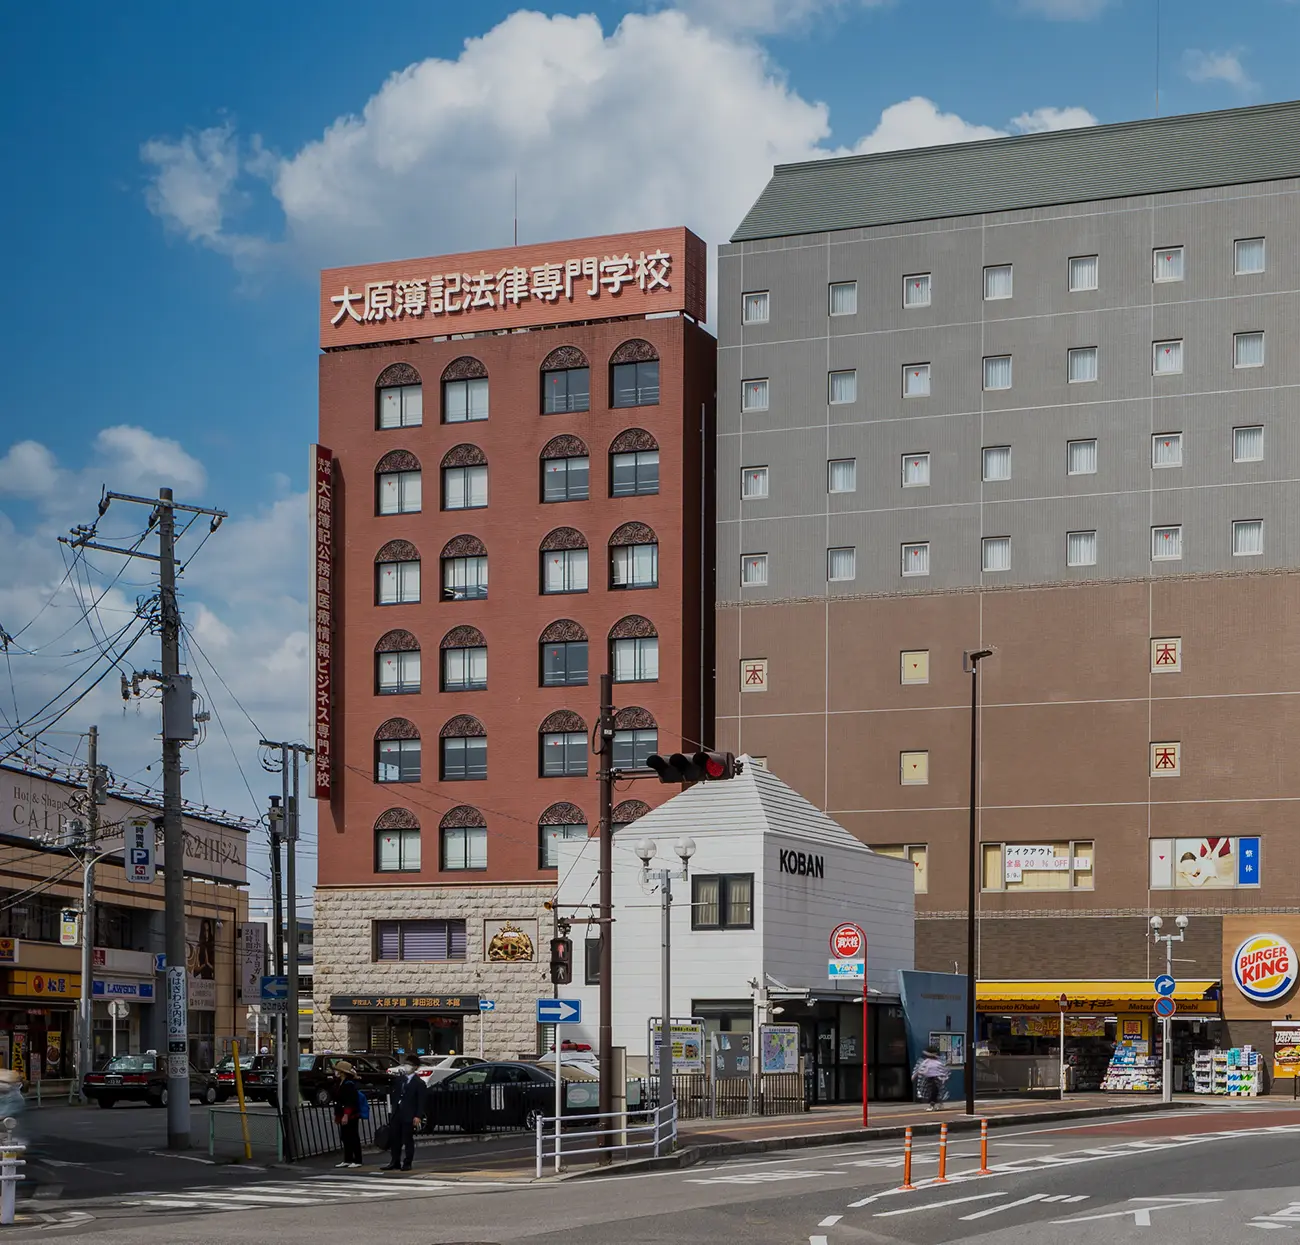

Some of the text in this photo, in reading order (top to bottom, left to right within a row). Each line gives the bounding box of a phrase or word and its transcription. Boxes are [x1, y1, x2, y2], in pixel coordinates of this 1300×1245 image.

[330, 249, 671, 325] 大原簿記法律専門学校
[1156, 643, 1176, 664] 本
[1156, 747, 1175, 768] 本
[32, 792, 39, 804] &
[133, 850, 147, 863] P
[780, 849, 824, 878] KOBAN
[1240, 946, 1288, 969] BURGER
[1241, 957, 1289, 985] KING
